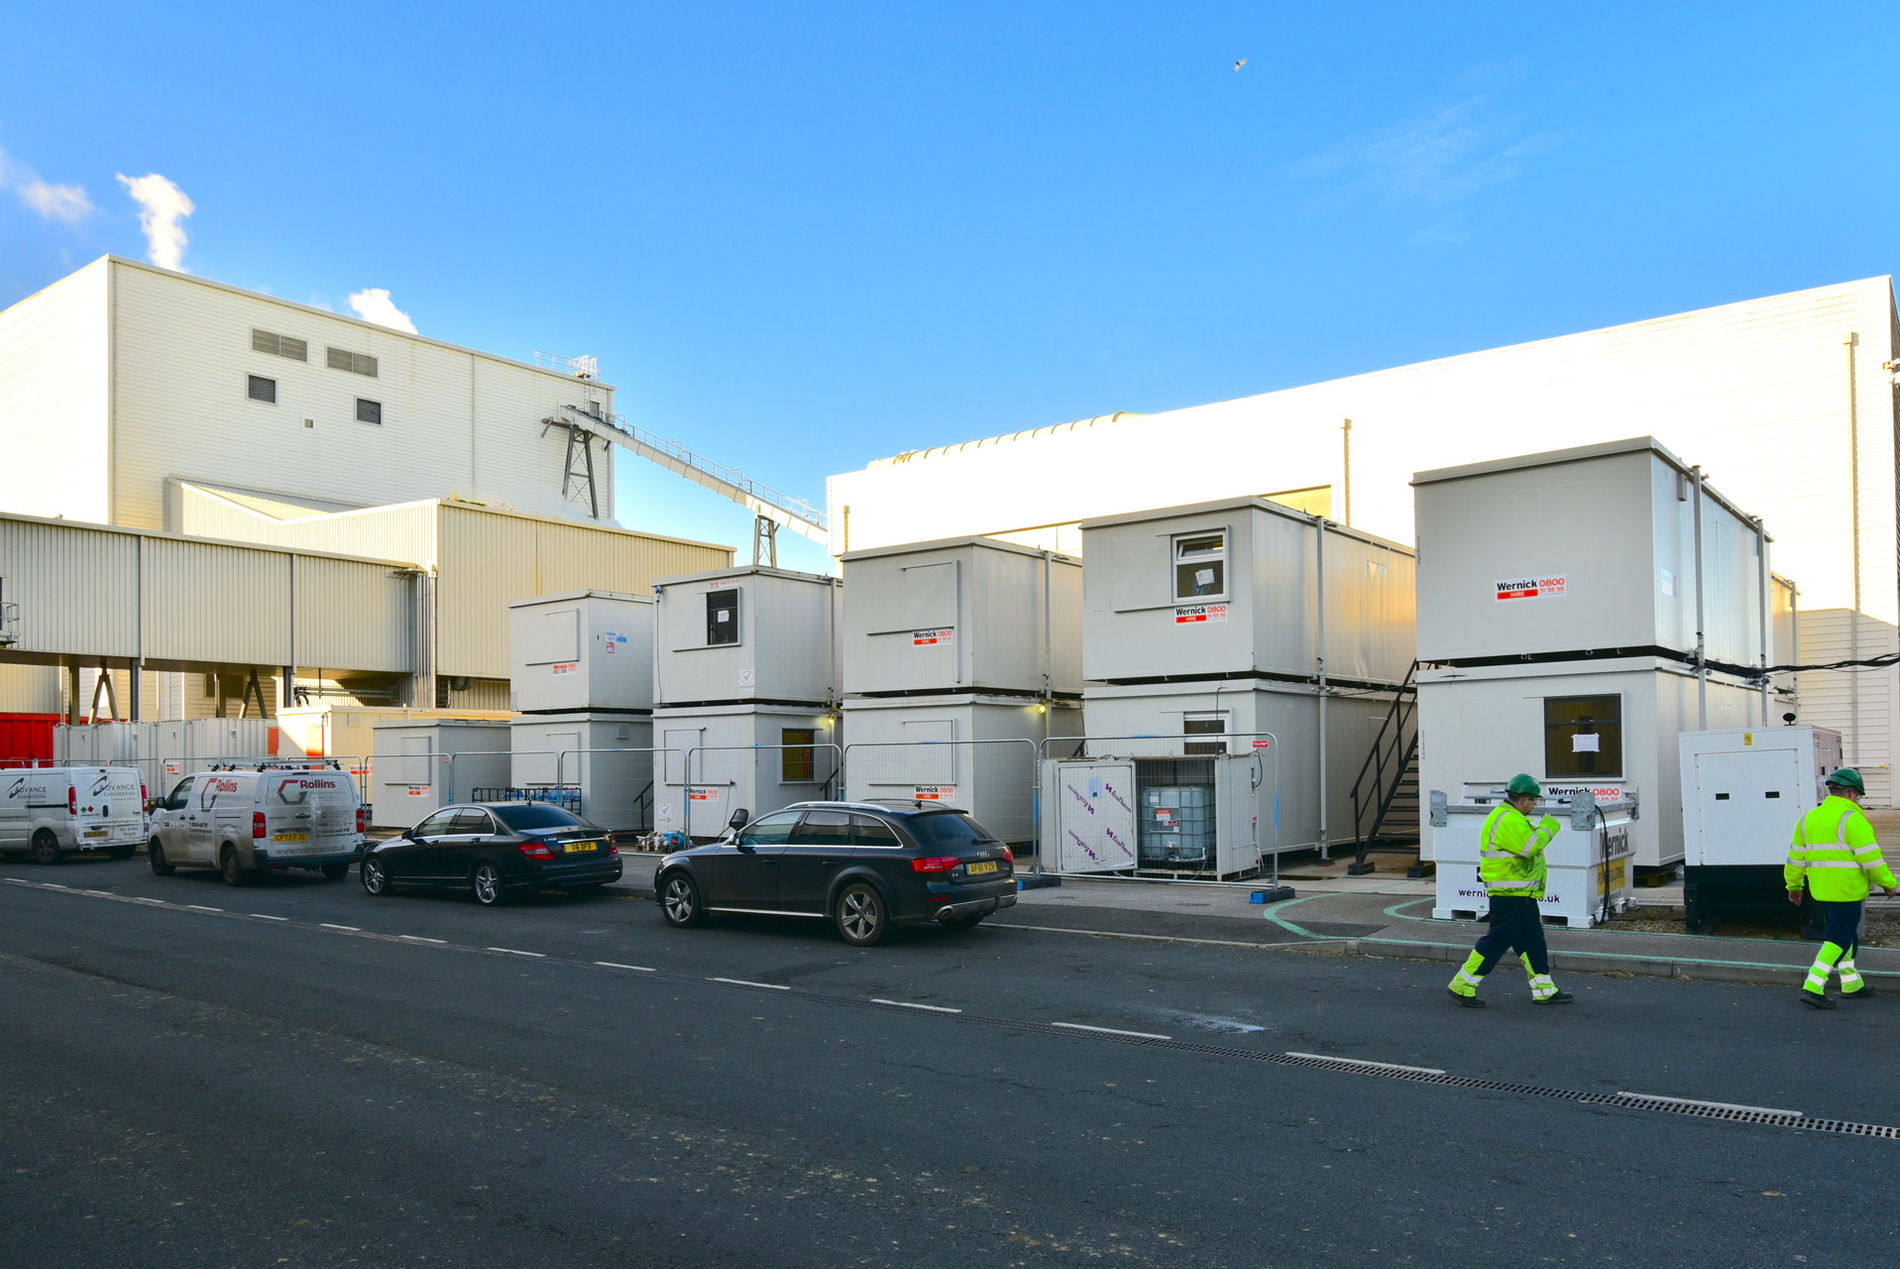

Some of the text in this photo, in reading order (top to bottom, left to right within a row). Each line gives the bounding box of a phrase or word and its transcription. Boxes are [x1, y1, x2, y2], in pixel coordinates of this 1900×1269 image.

[1497, 577, 1565, 591] Wernick 0800
[1176, 606, 1206, 616] Wernick
[1207, 605, 1227, 613] 0800
[914, 631, 937, 639] Wernick
[215, 779, 239, 793] Rollins
[300, 779, 336, 789] Rollins
[916, 784, 938, 793] Wernick
[1593, 788, 1619, 796] 0800
[1111, 790, 1132, 814] EcoTherm
[1112, 836, 1133, 859] EcoTherm
